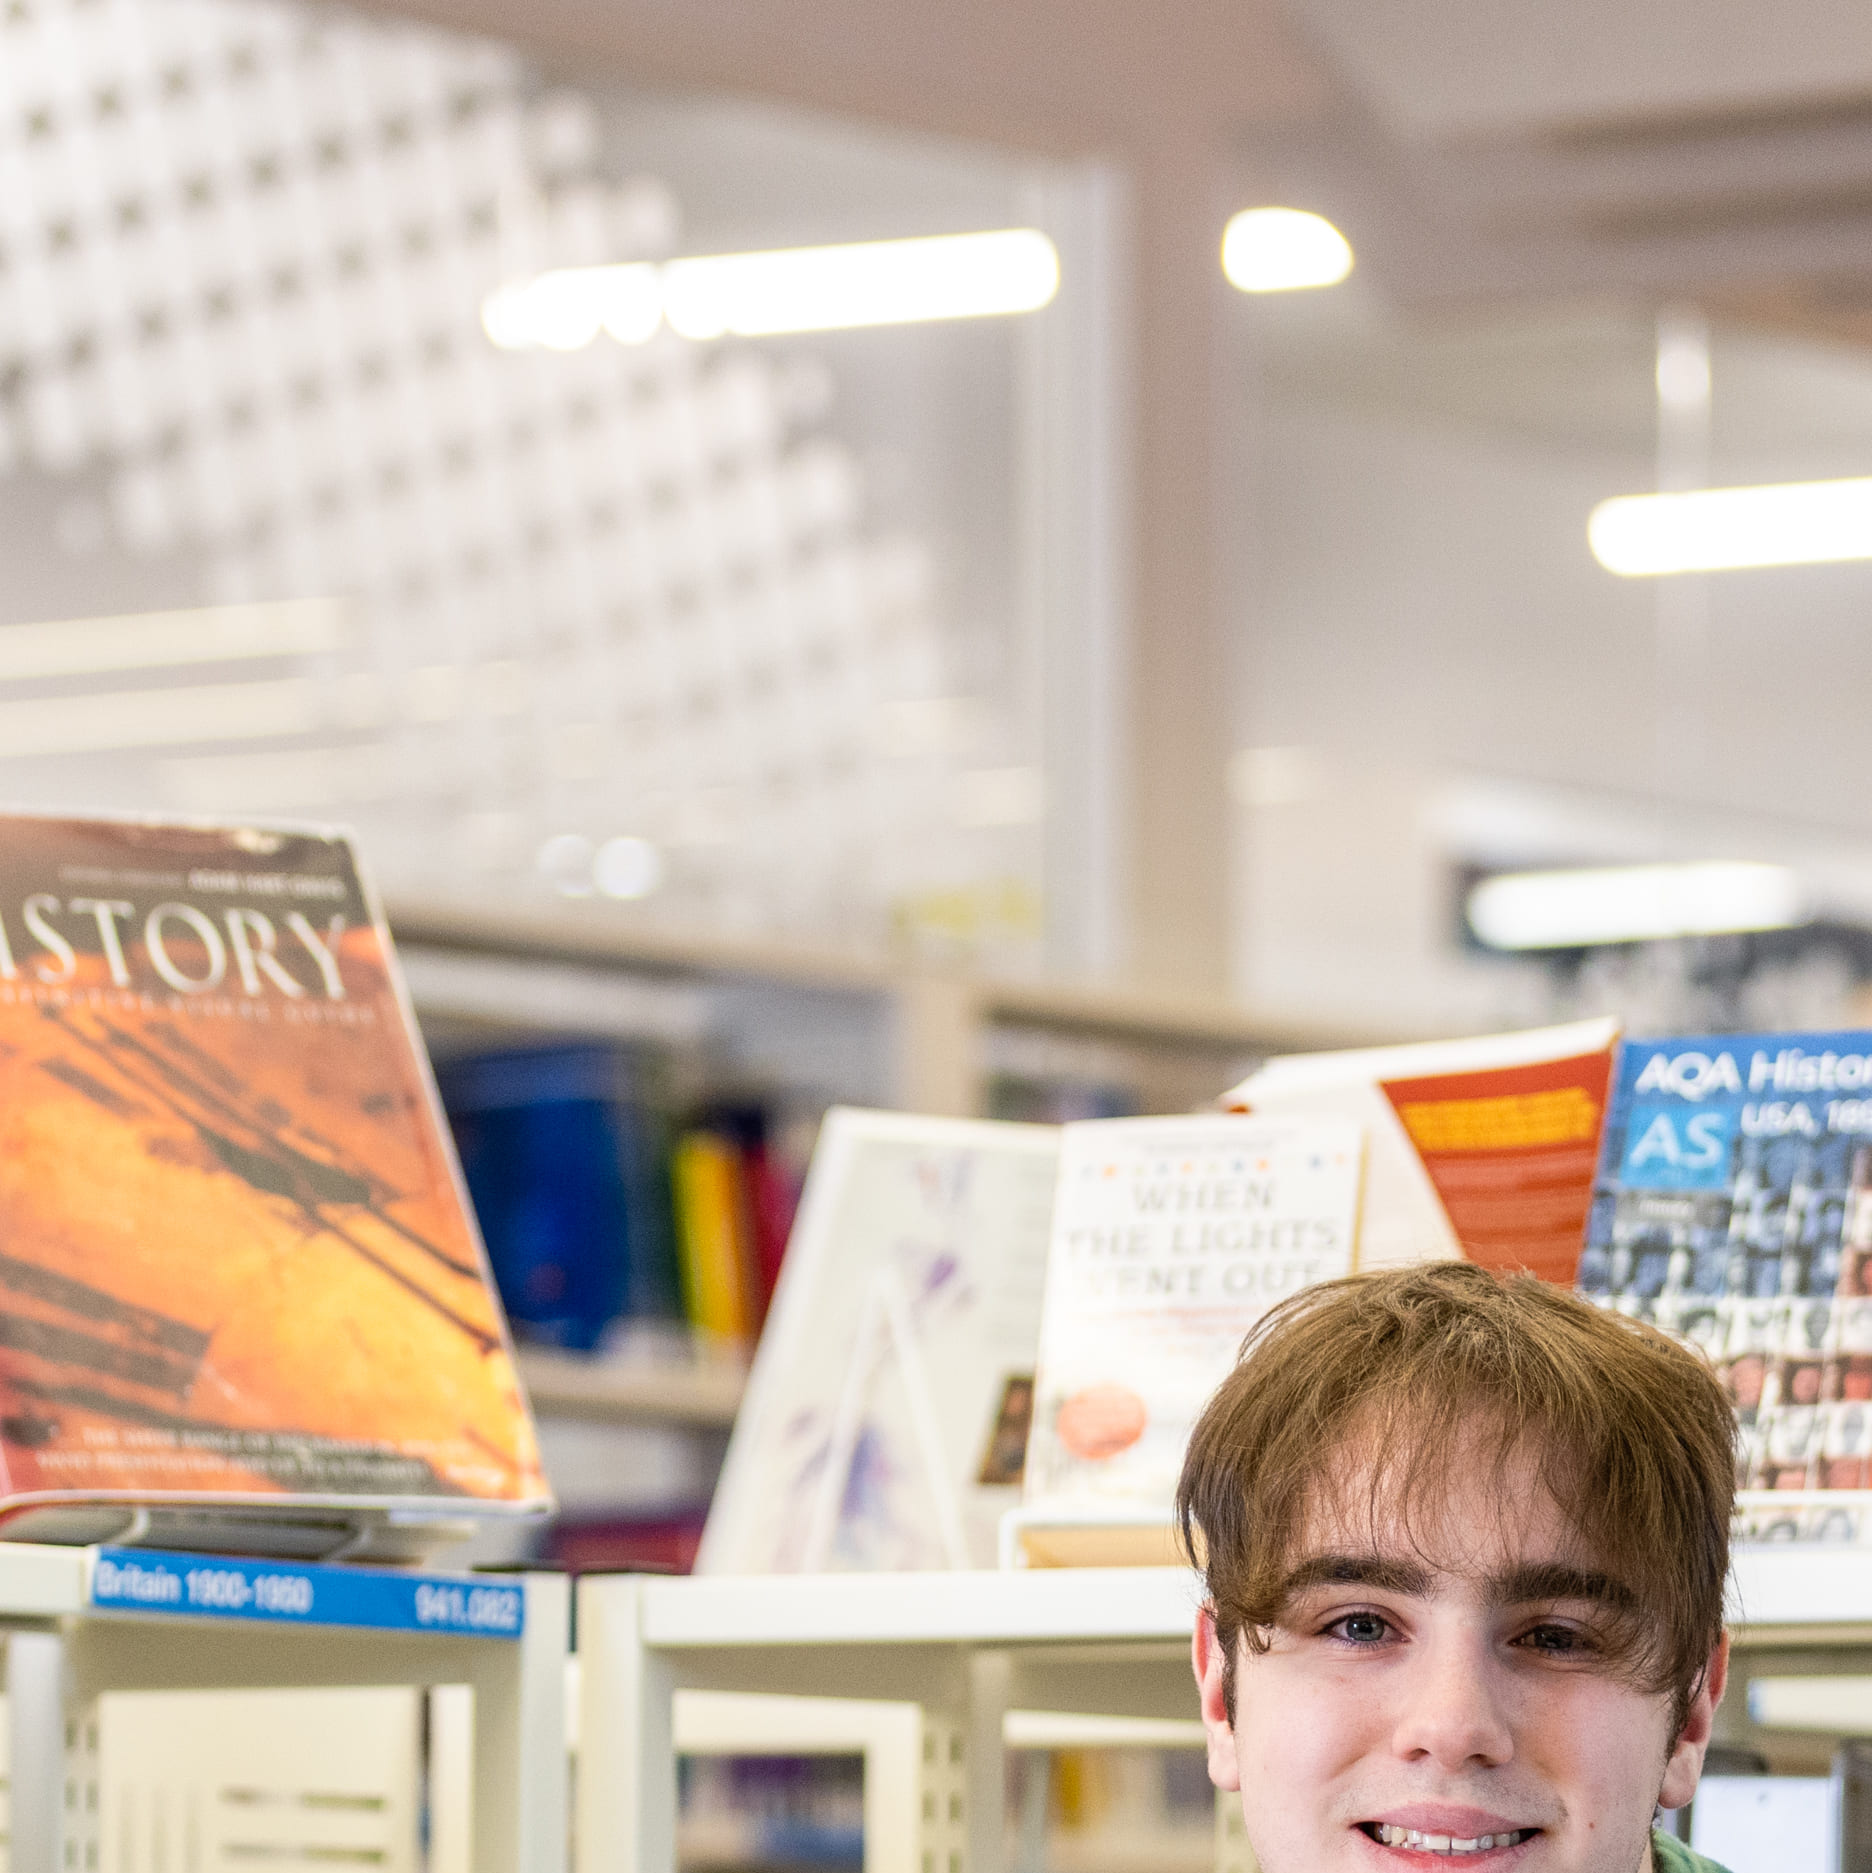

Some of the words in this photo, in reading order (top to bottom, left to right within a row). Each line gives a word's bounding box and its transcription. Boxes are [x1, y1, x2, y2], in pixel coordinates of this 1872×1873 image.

[1634, 1051, 1741, 1101] AQA
[1628, 1111, 1725, 1169] AS
[1131, 1180, 1273, 1212] WHEN
[95, 1560, 183, 1603] Britain
